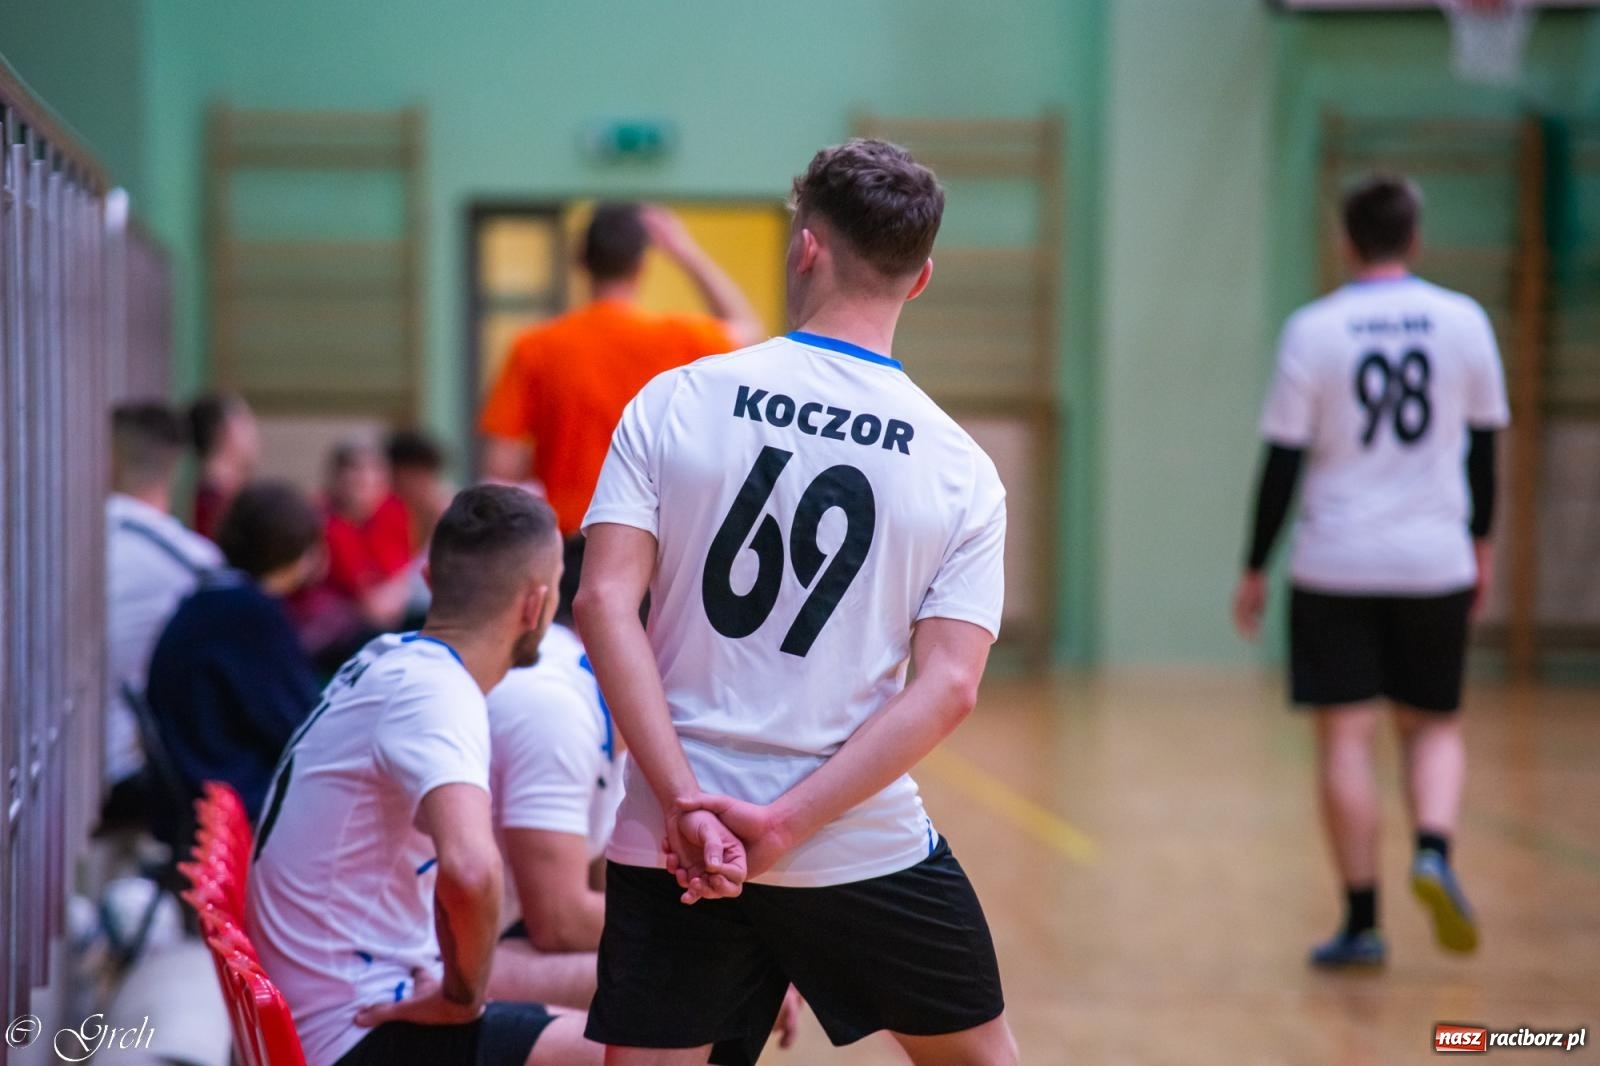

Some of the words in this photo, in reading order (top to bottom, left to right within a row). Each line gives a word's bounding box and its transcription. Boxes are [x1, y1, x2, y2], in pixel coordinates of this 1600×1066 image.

[733, 385, 915, 455] KOCZOR
[1356, 350, 1431, 446] 98
[702, 445, 876, 657] 69
